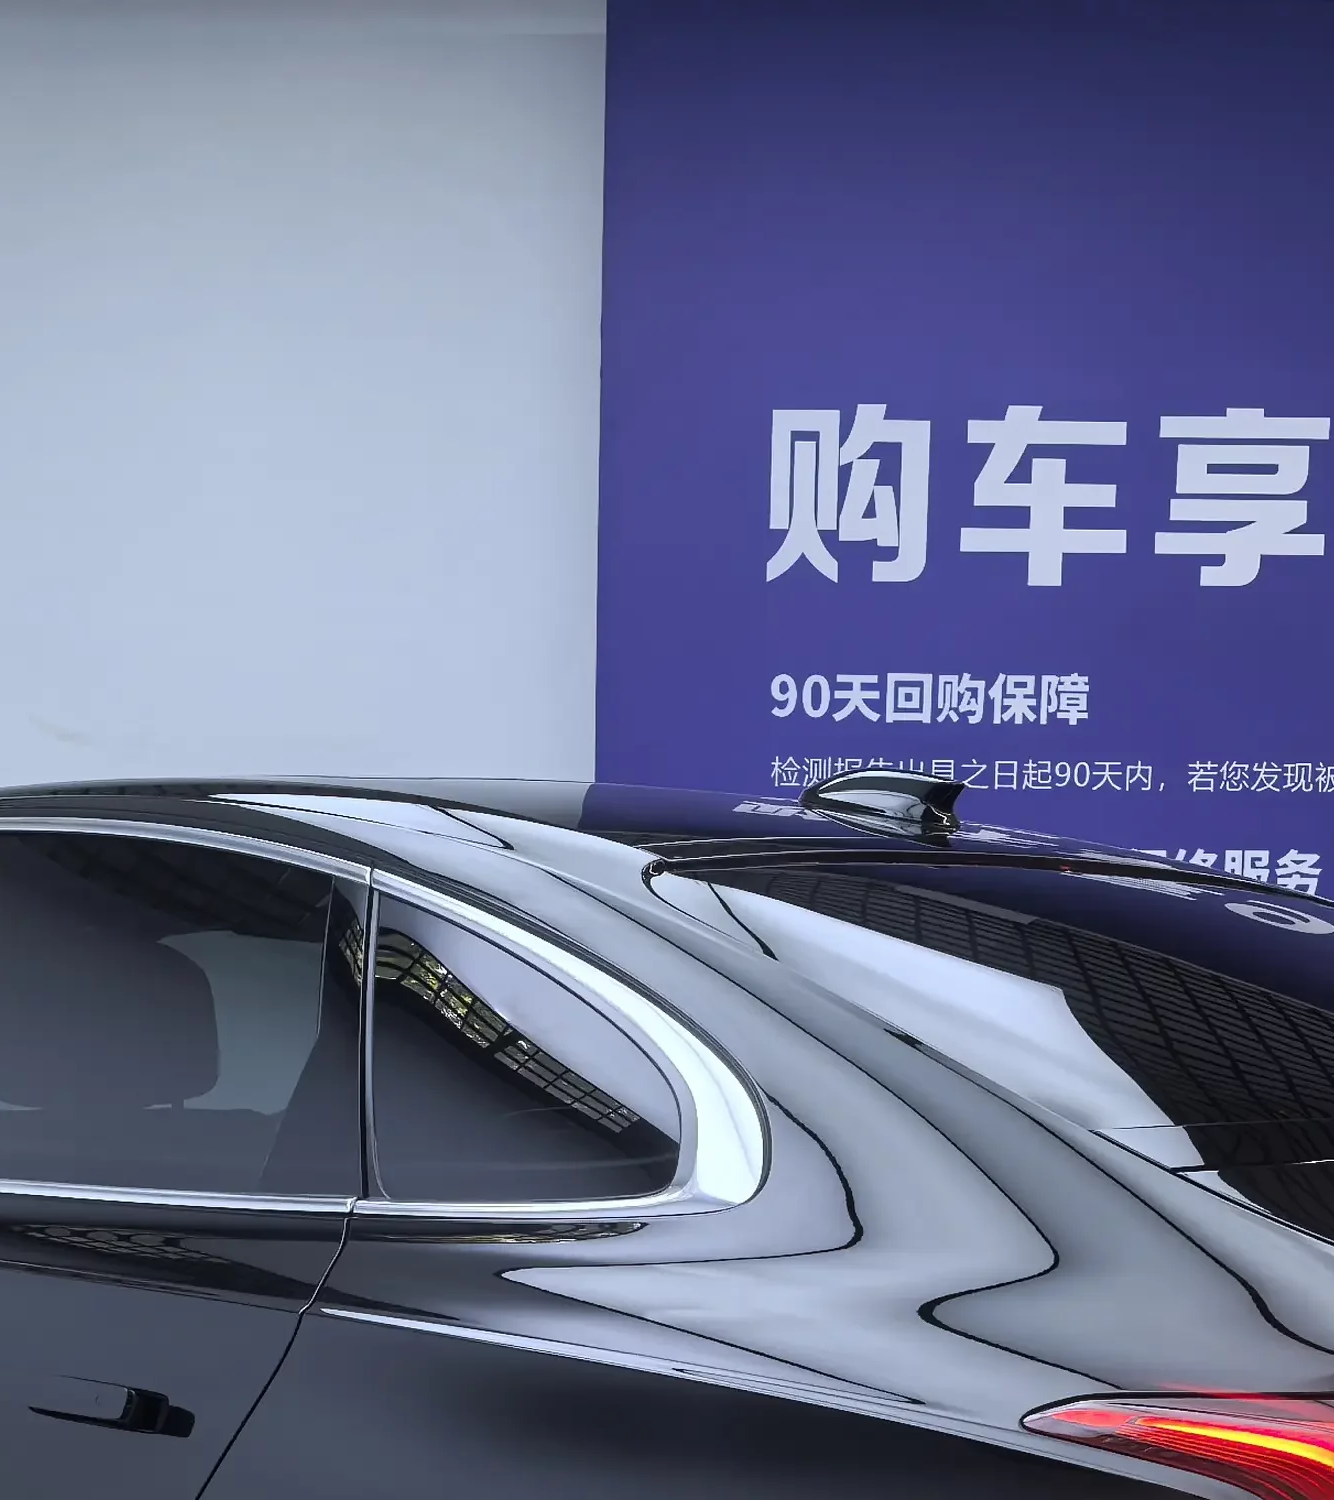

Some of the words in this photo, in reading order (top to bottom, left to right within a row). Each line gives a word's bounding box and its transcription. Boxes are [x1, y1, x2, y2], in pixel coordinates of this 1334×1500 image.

[771, 673, 1089, 725] 90天回购保障
